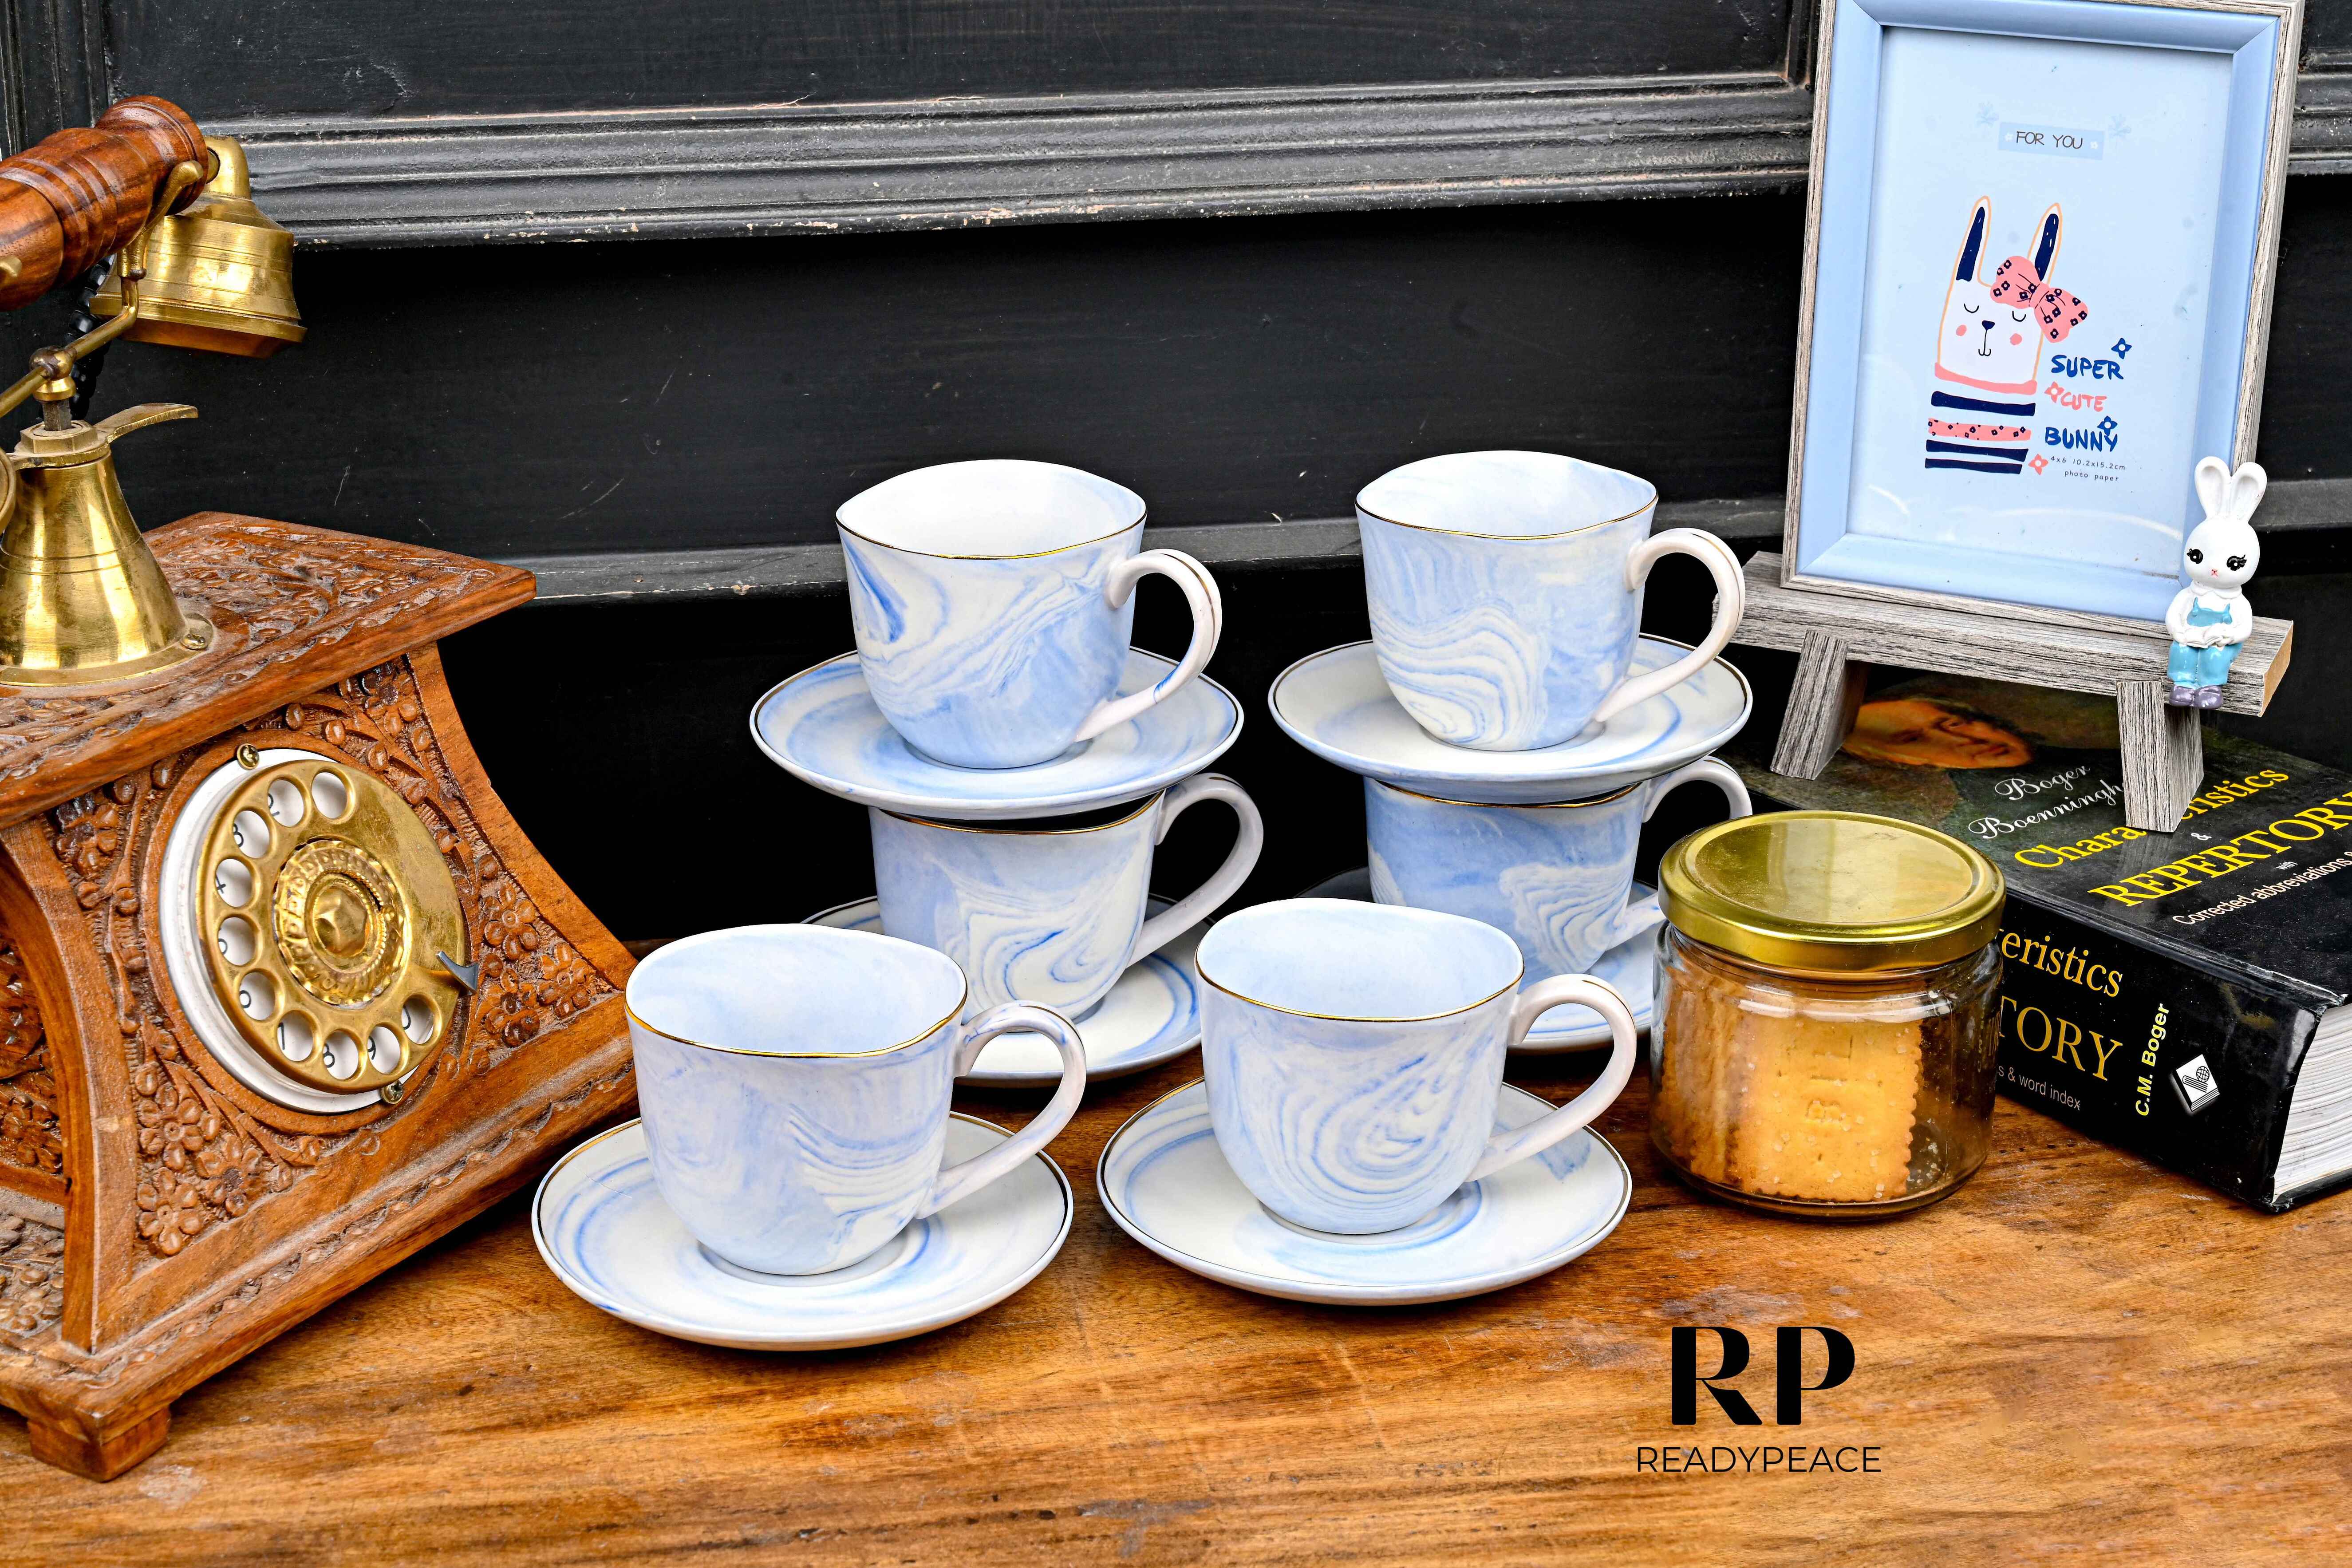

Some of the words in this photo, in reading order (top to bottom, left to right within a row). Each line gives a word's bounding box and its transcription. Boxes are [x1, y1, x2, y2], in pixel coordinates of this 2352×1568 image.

[2016, 131, 2045, 146] FOR
[2052, 134, 2083, 149] YOU
[2051, 354, 2124, 380] SUPER
[2060, 391, 2107, 412] CUTE
[2044, 427, 2118, 452] BUNNY
[2072, 458, 2125, 470] 10.2x15.2cm
[1995, 766, 2090, 800] Boger
[1968, 779, 2124, 839] Boenningh
[2014, 769, 2289, 868] Chararistics
[2276, 860, 2299, 871] with
[2172, 894, 2257, 925] Corrected
[2251, 857, 2352, 900] abbreviations
[1999, 928, 2123, 997] eristics
[2142, 1003, 2169, 1067] Boger
[2008, 1067, 2016, 1082] &
[2019, 1074, 2046, 1096] word
[2050, 1084, 2080, 1110] index
[2136, 1074, 2153, 1116] C.M.
